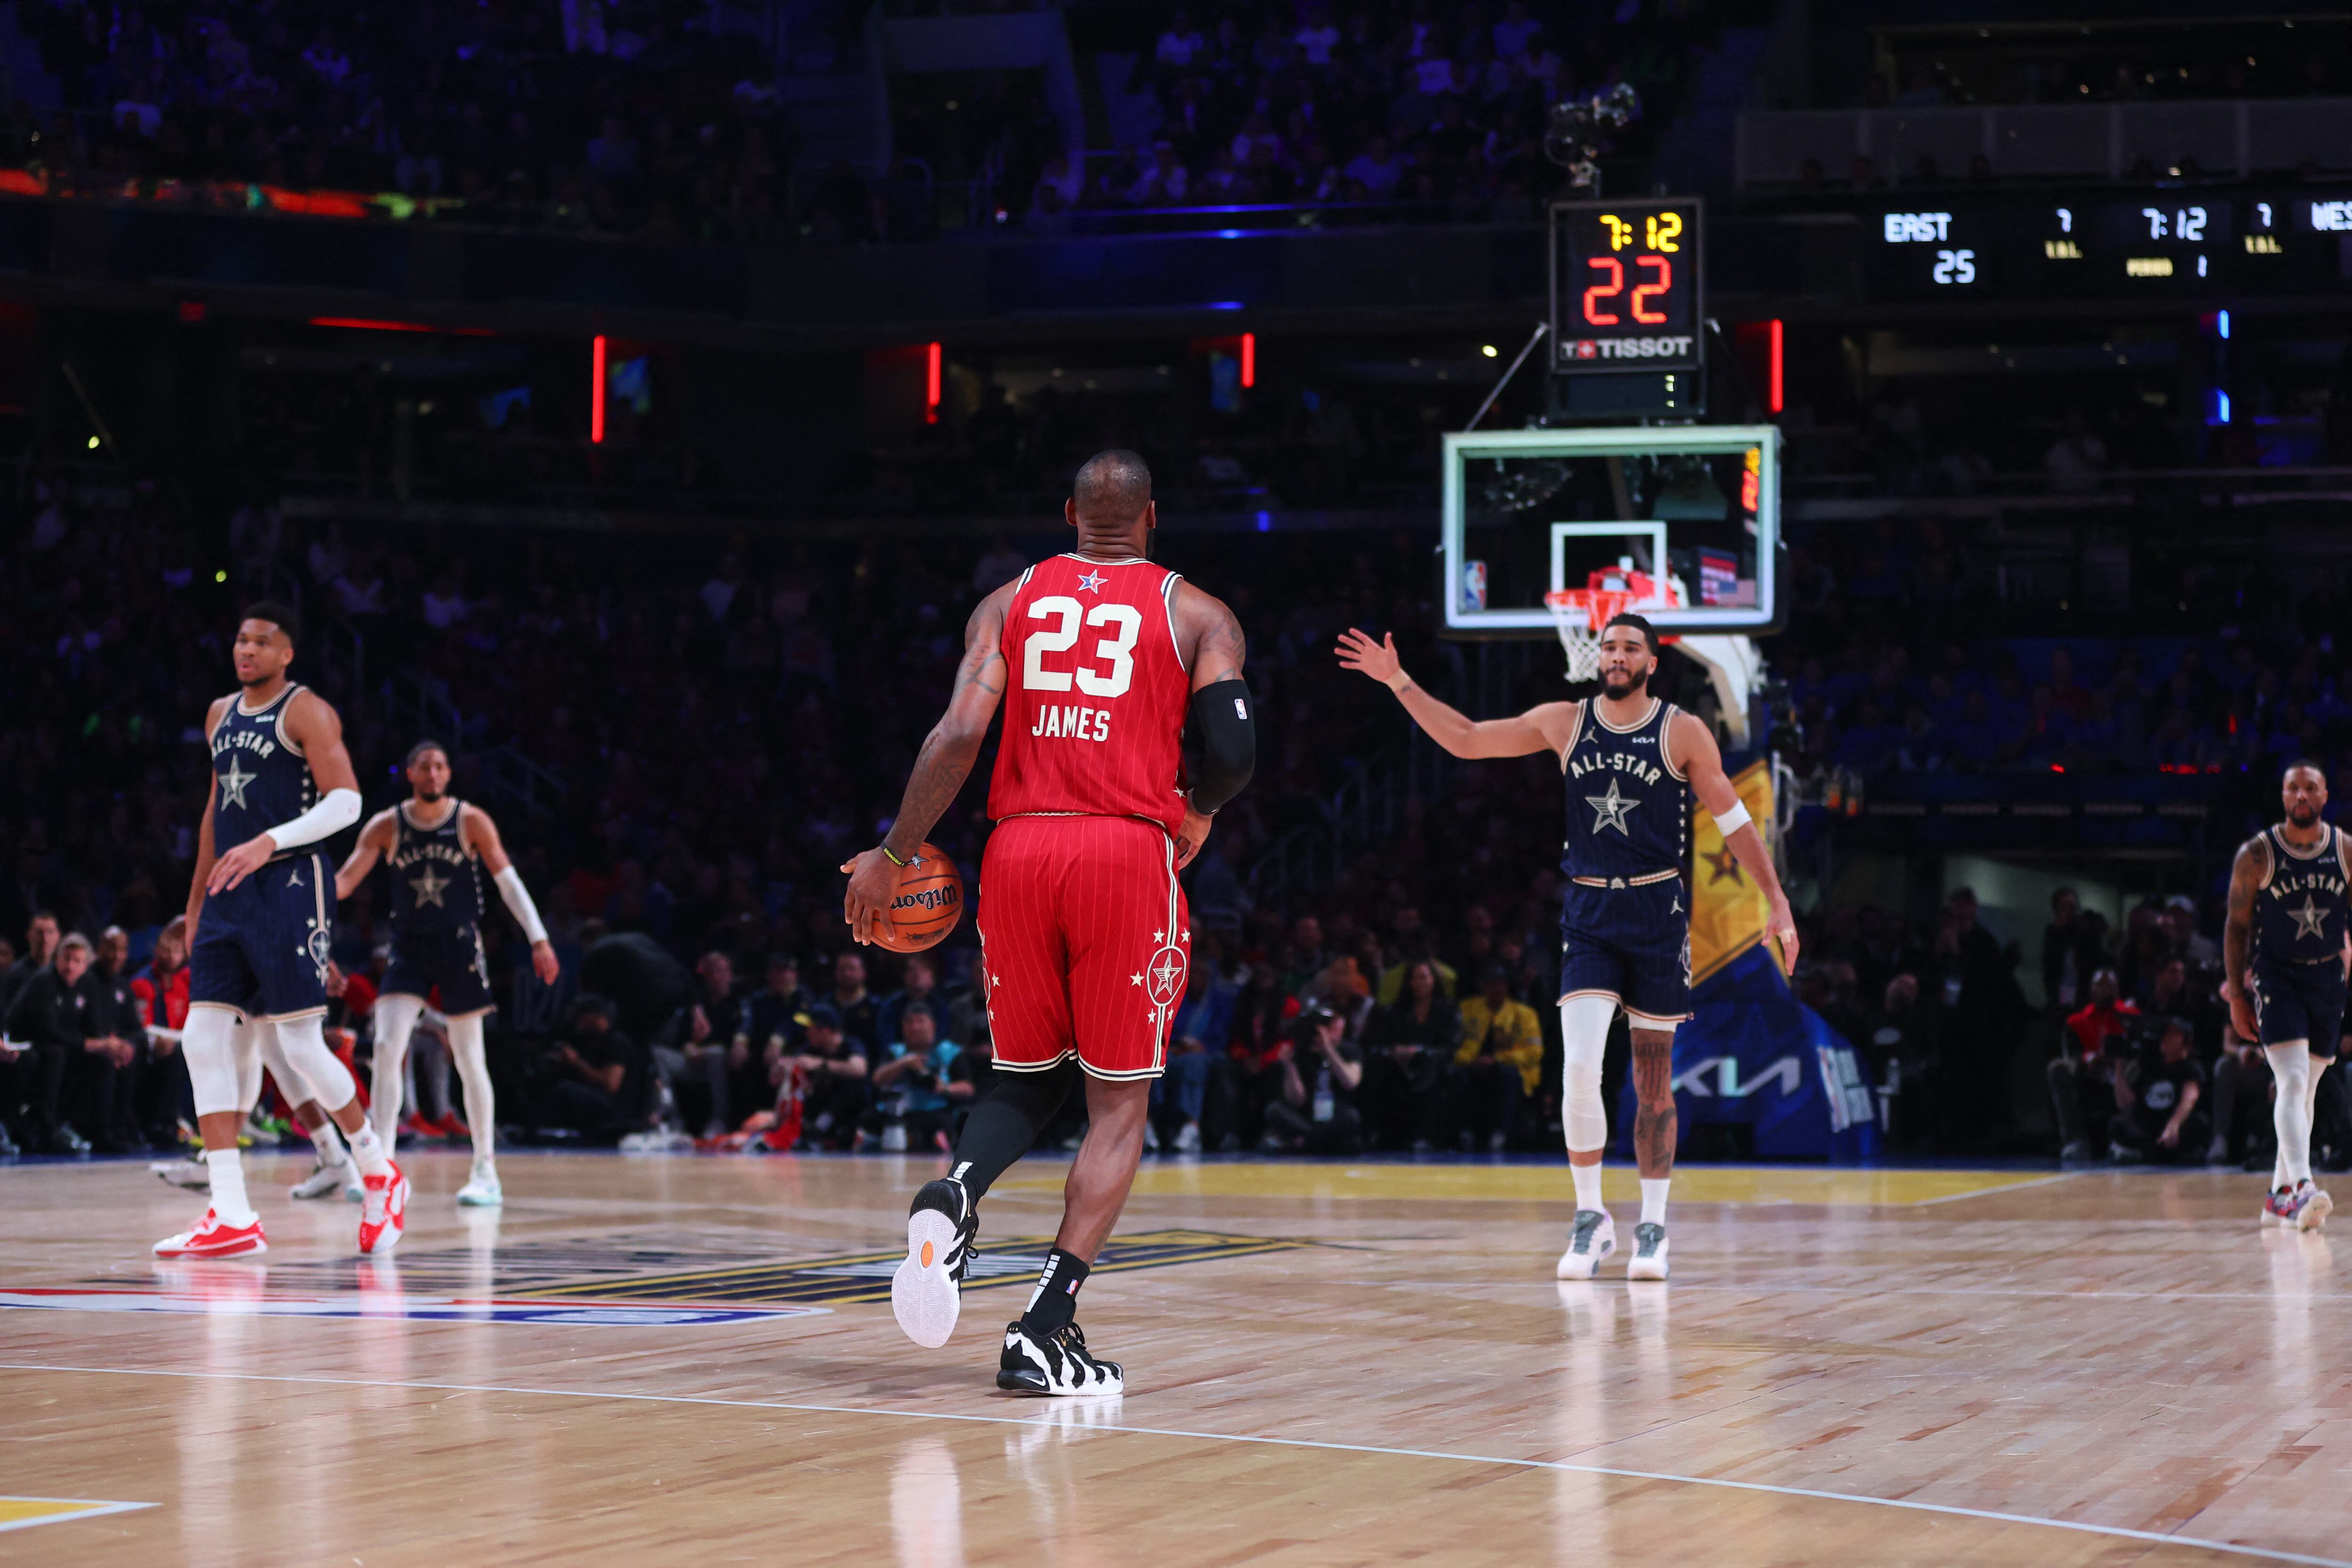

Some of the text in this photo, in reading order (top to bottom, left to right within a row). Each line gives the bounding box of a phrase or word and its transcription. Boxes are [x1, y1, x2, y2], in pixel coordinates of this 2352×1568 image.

[1883, 212, 1953, 243] EAST
[2056, 208, 2072, 232] 7
[2142, 206, 2207, 241] 7:12
[2257, 203, 2272, 227] 7
[1599, 212, 1682, 253] 7:12
[1933, 249, 1975, 284] 25
[2197, 255, 2208, 277] 1
[1583, 255, 1672, 326] 22
[1596, 336, 1693, 358] TISSOT
[1023, 595, 1143, 698] 23
[1032, 705, 1111, 742] JAMES
[1570, 752, 1662, 786] ALL-STAR
[396, 842, 465, 871] ALL-STAR
[884, 848, 902, 865] PROMISE
[890, 884, 958, 911] Wilson
